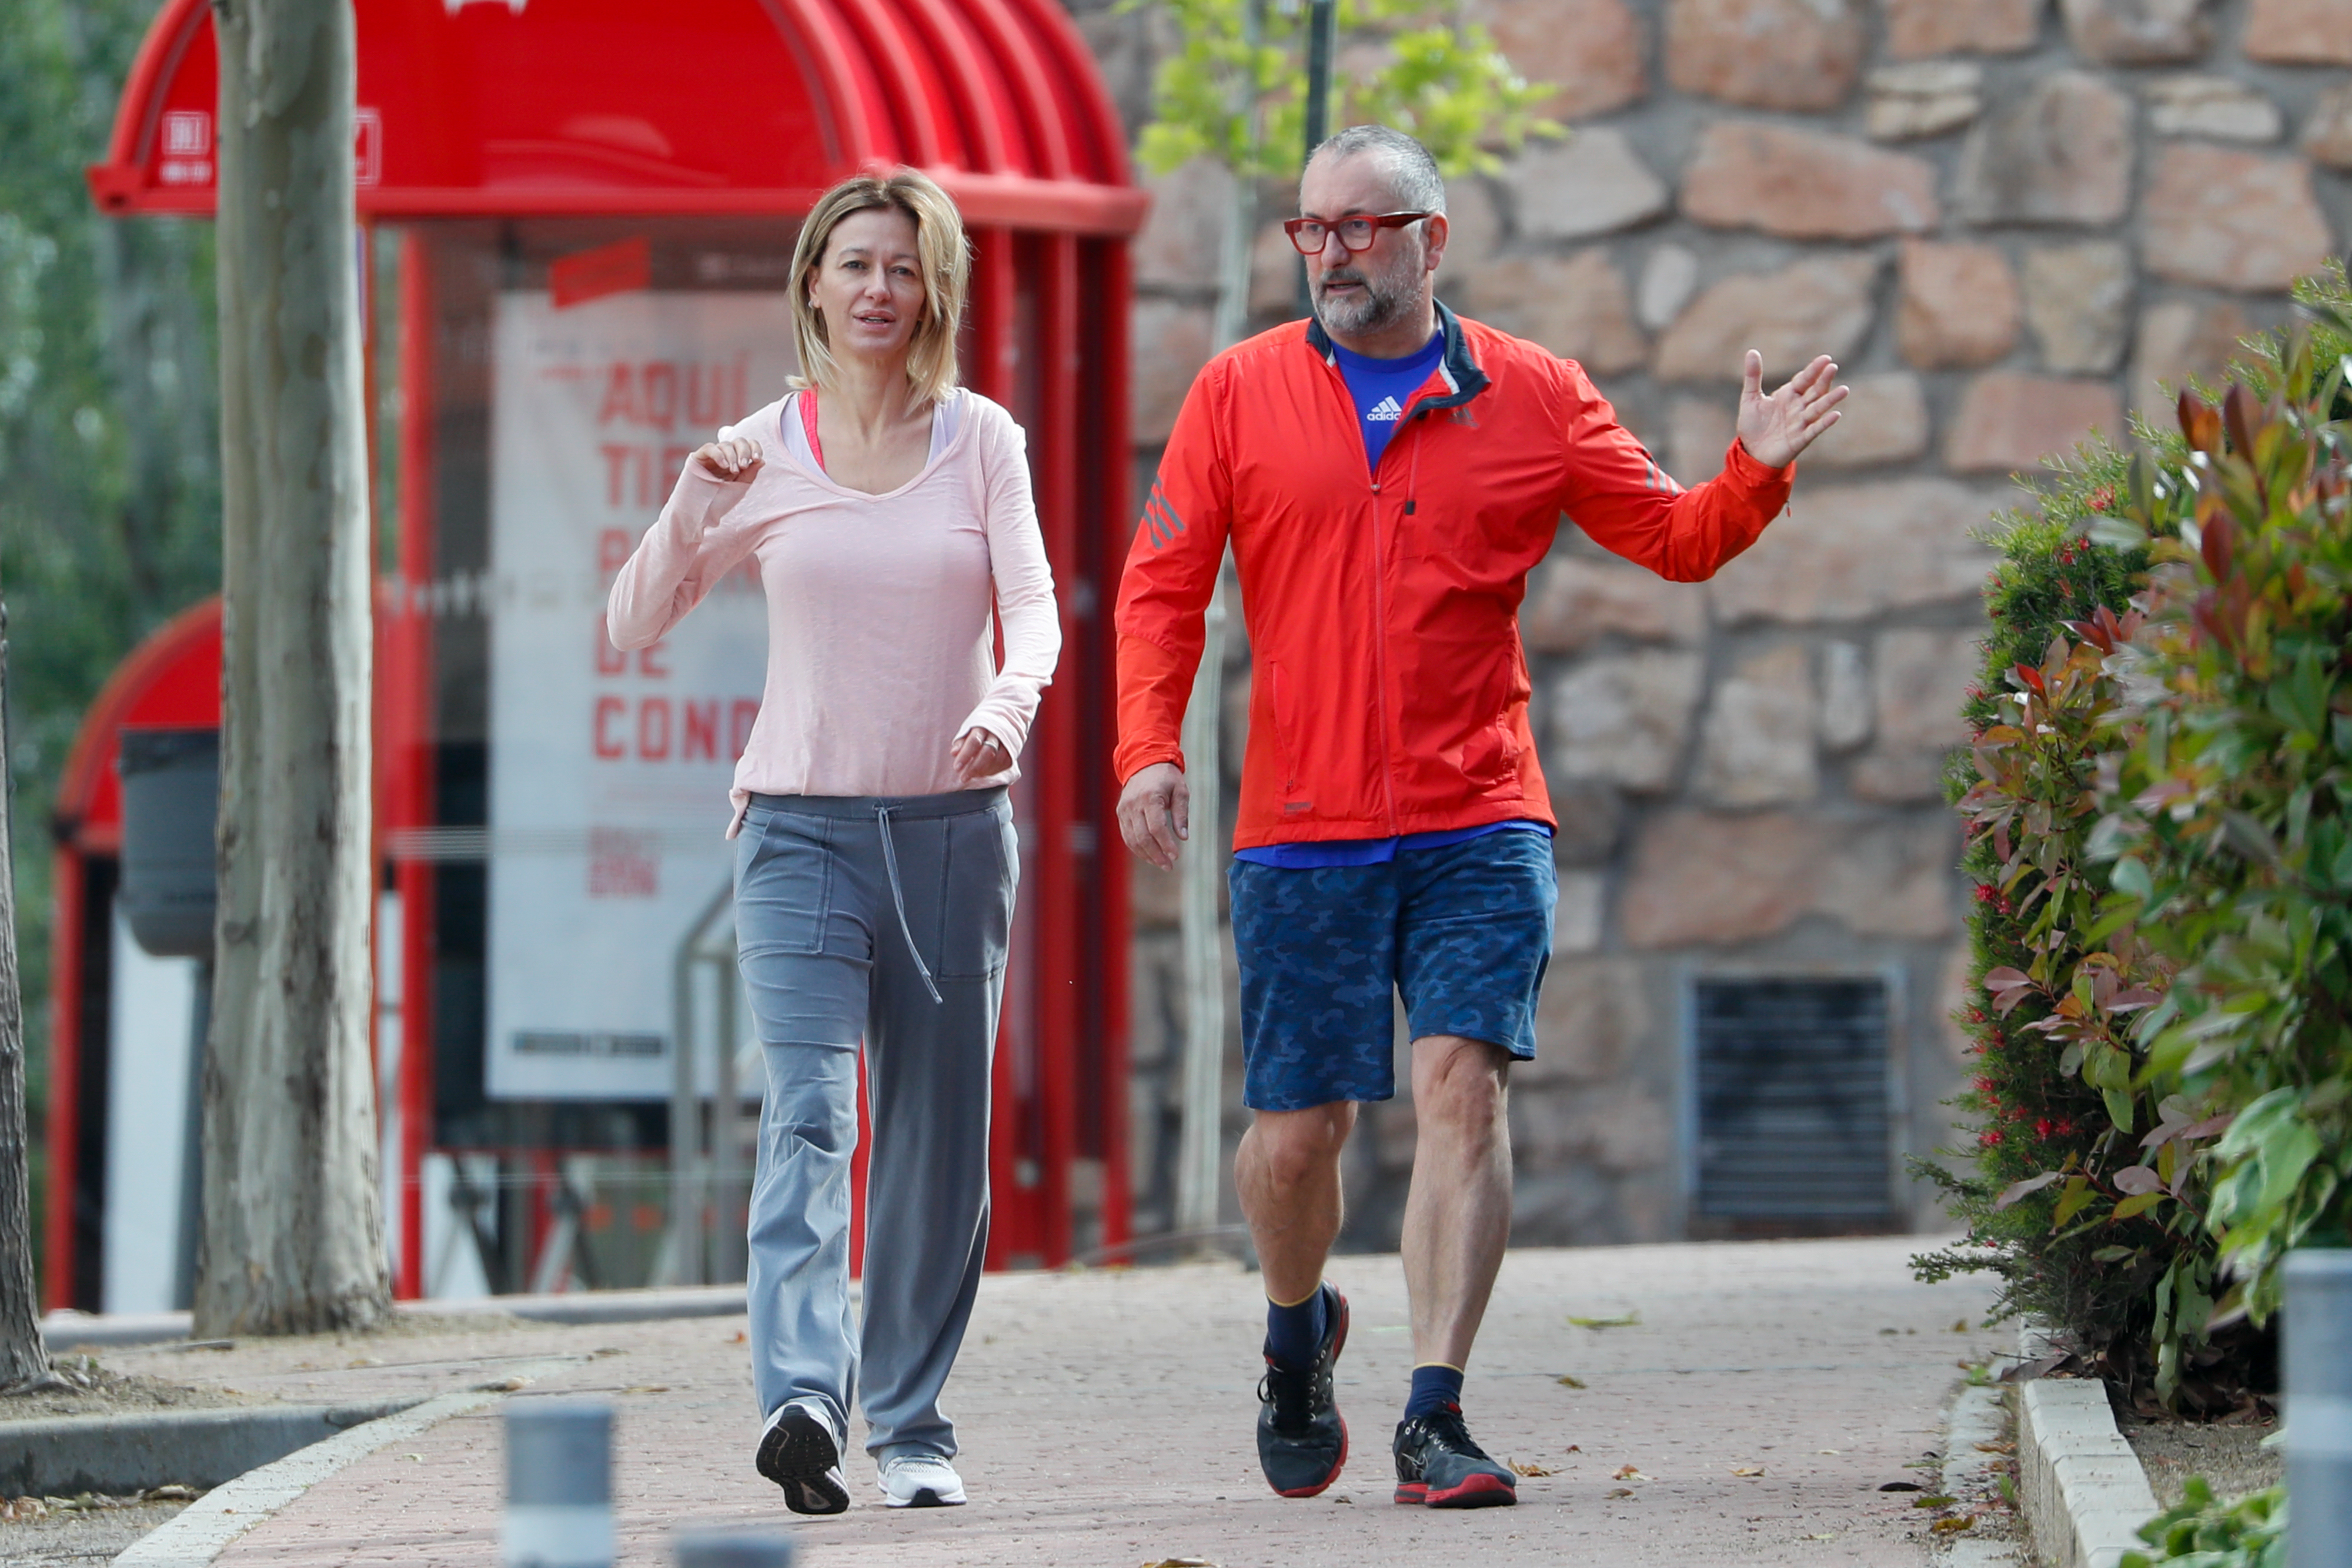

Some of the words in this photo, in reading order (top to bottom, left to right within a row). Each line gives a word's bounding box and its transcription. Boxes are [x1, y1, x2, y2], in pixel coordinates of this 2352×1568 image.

[1367, 412, 1401, 421] adida
[599, 443, 690, 508] TIE
[594, 696, 763, 761] COND
